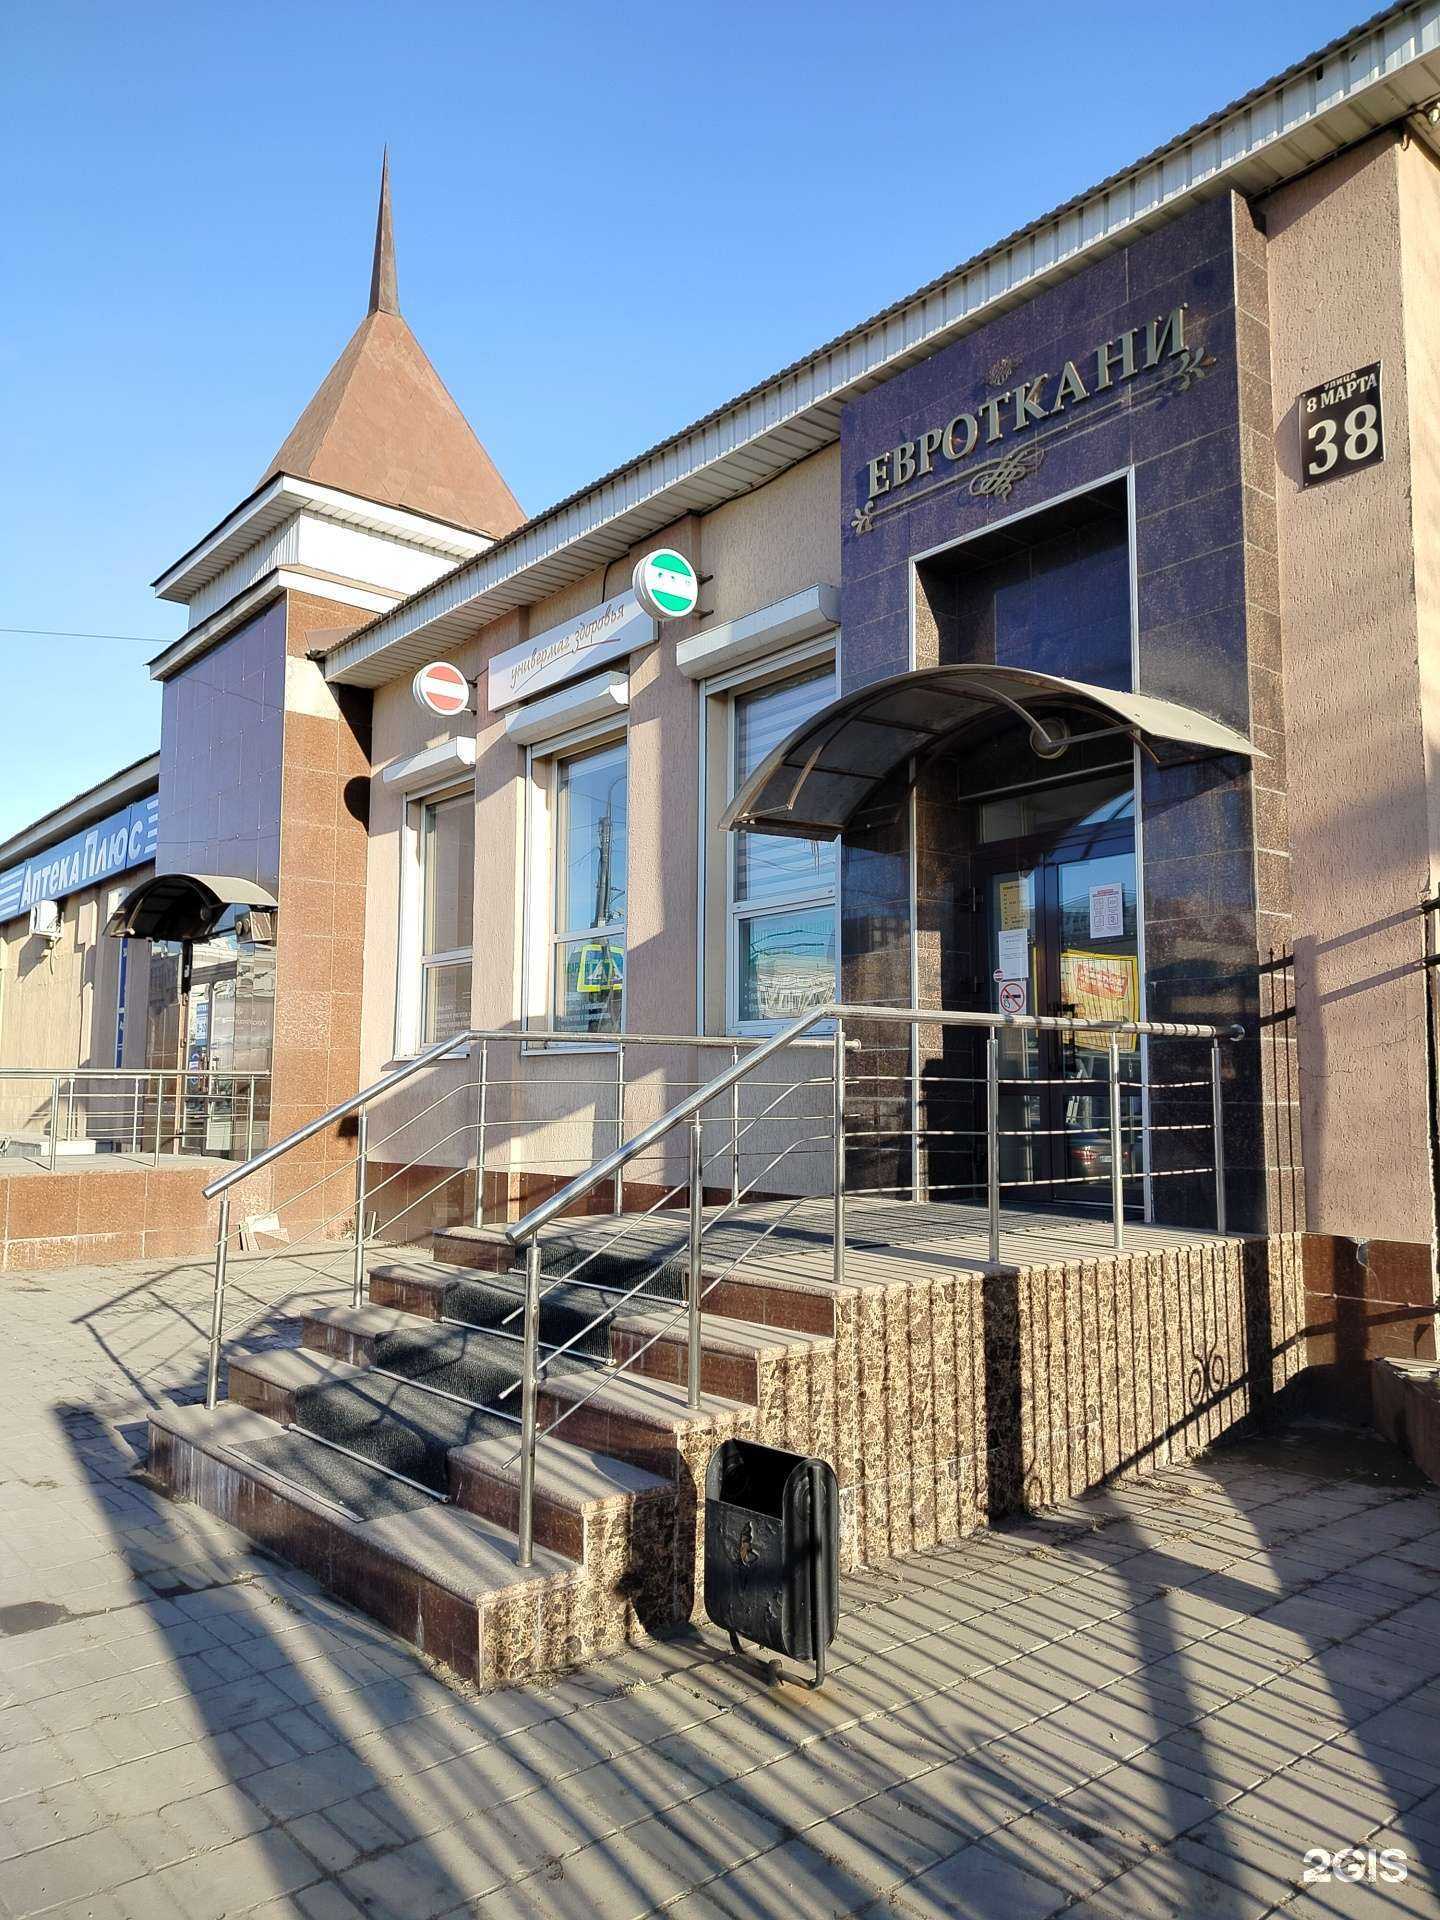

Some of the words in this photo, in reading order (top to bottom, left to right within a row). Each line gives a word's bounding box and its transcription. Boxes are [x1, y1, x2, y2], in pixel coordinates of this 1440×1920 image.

[866, 302, 1188, 499] ЕВРОТКАНИ
[1306, 396, 1317, 413] 8
[1320, 373, 1378, 408] МАРТА
[1323, 372, 1357, 390] УЛИЦА
[1308, 404, 1379, 475] 38
[511, 636, 570, 688] универмаг
[575, 603, 625, 649] здоровья
